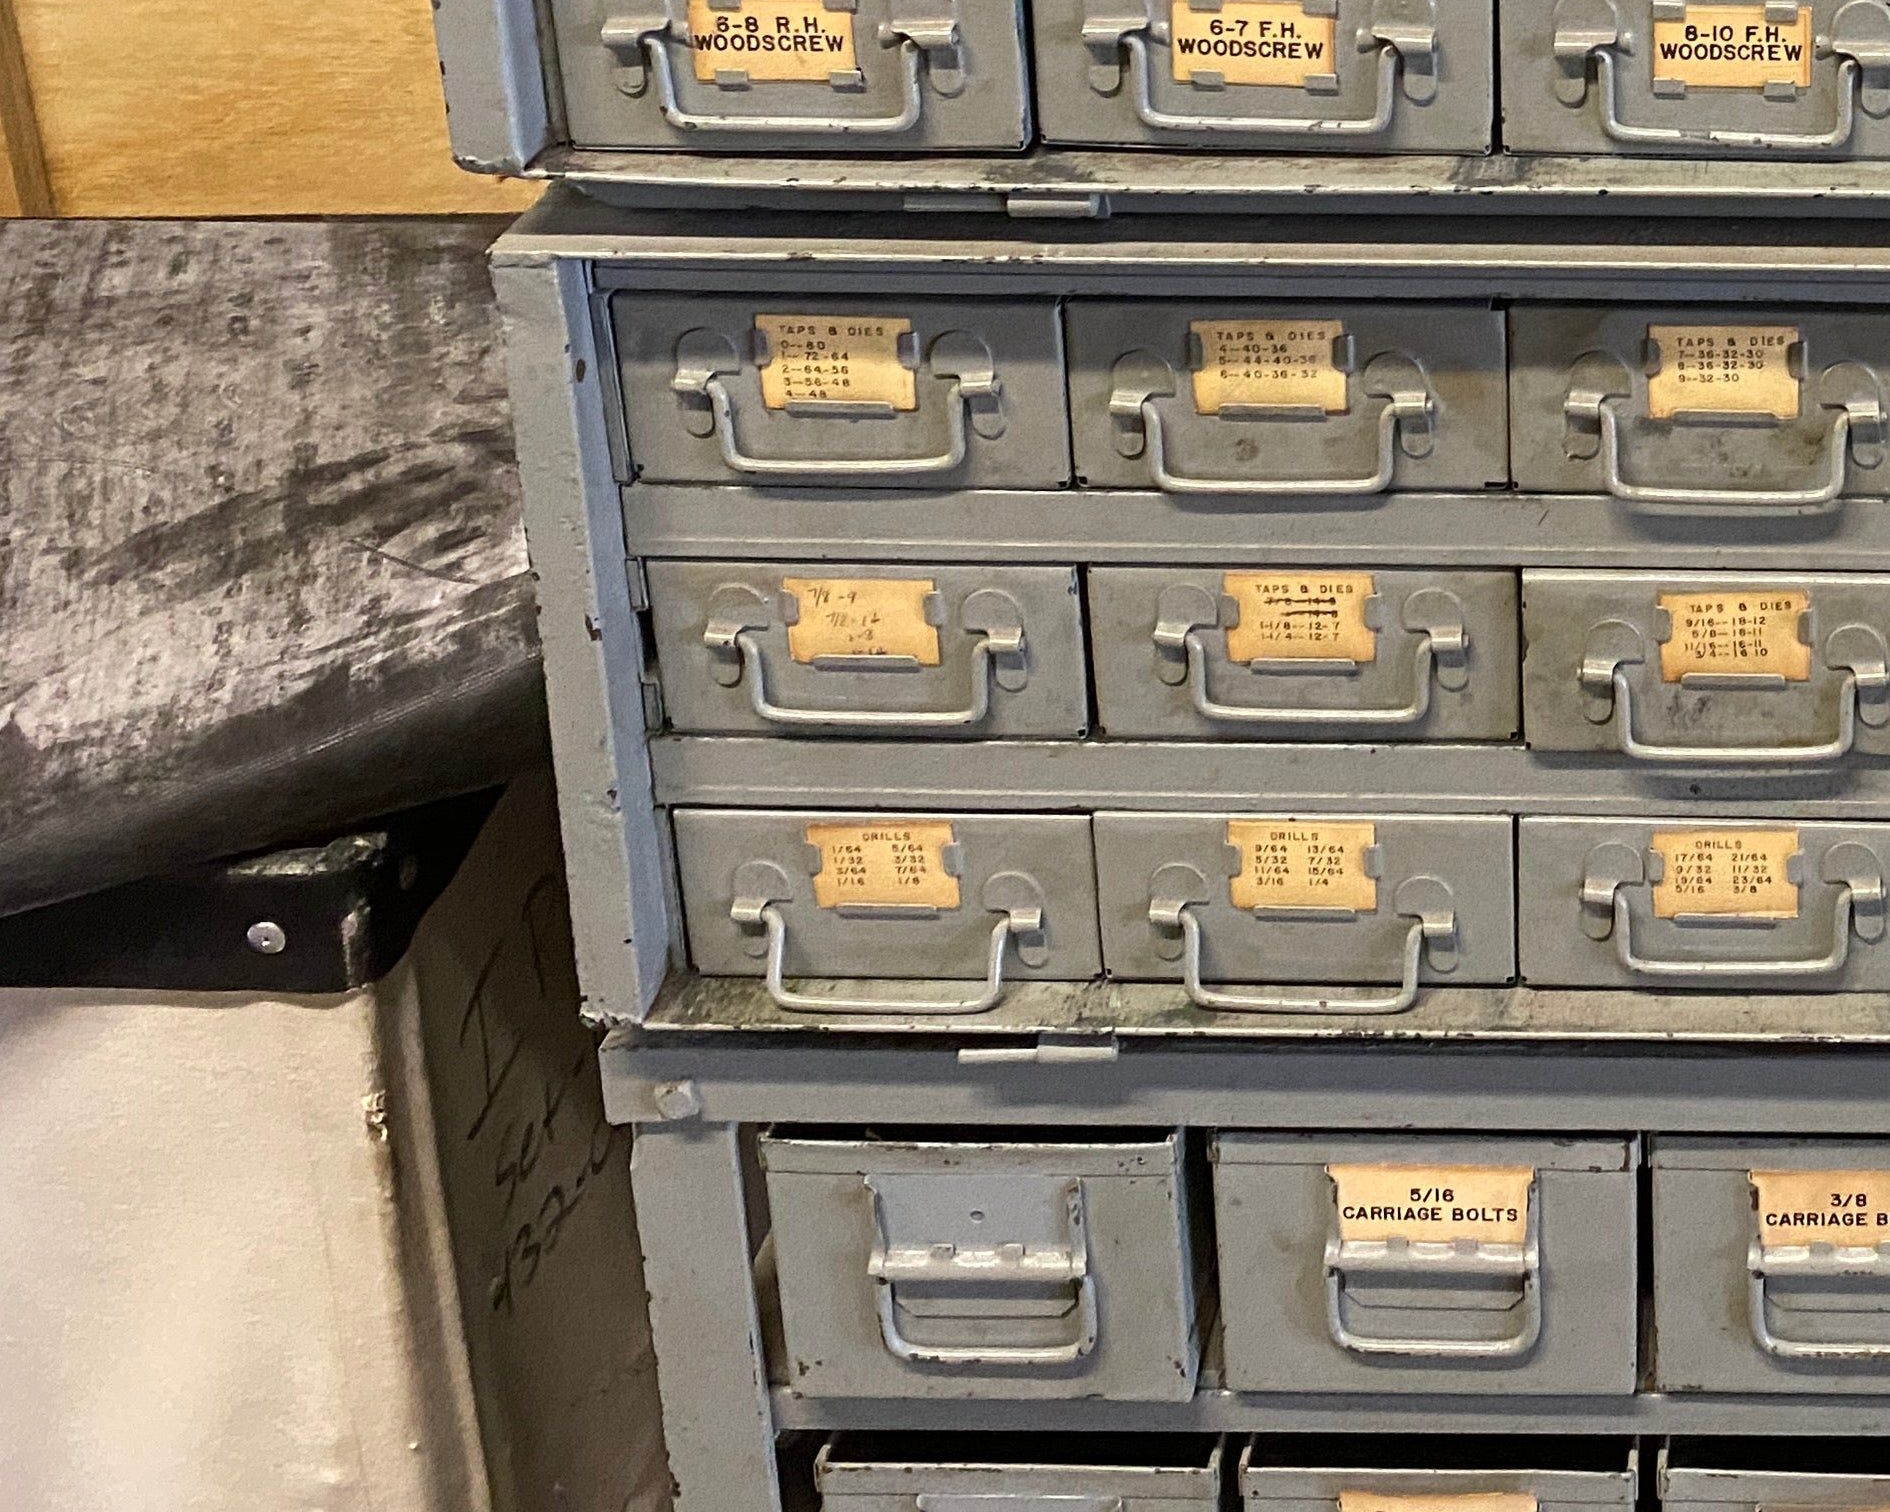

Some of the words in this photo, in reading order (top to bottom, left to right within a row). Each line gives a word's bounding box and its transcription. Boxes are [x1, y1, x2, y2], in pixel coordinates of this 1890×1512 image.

[776, 16, 825, 33] R.H.
[1210, 19, 1248, 36] 6-7
[1259, 21, 1301, 39] F.H.
[1685, 25, 1733, 41] 8-10
[1746, 26, 1786, 42] F.H.
[691, 34, 843, 52] WOODSCREW
[1178, 38, 1323, 59] WOODSCREW
[1660, 43, 1802, 61] WOODSCREW
[779, 325, 816, 335] TAPS
[847, 326, 883, 336] DIES
[1217, 332, 1254, 341] TAPS
[1288, 331, 1326, 341] DIES
[1677, 337, 1714, 347] TAPS
[1750, 336, 1784, 346] DIES
[1256, 584, 1289, 594] TAPS
[1320, 584, 1353, 594] DIES
[1690, 603, 1724, 613] TAPS
[1760, 601, 1791, 611] DIES
[862, 832, 911, 842] DRILLS
[1270, 832, 1318, 841] DRILLS
[1695, 840, 1742, 850] DRILLS
[1410, 1188, 1454, 1203] 5/16
[1831, 1194, 1867, 1207] 3/8
[1343, 1207, 1442, 1221] CARRIAGE
[1452, 1208, 1517, 1222] BOLTS
[1766, 1213, 1867, 1226] CARRIAGE
